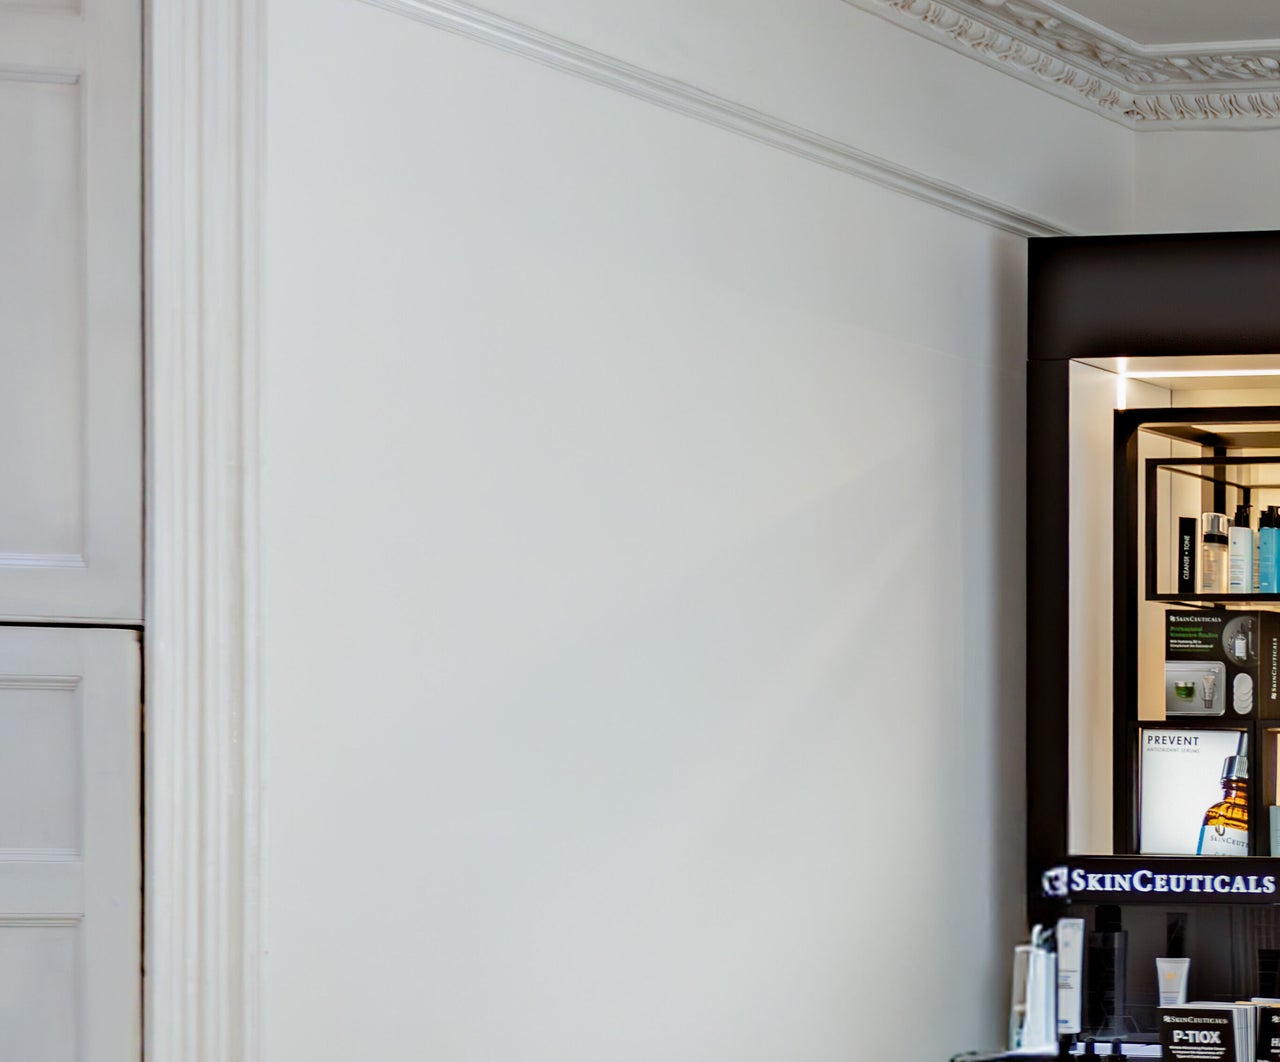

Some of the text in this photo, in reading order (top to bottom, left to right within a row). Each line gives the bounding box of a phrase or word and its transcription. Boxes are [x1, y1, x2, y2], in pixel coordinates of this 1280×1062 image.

[1148, 736, 1199, 746] PREVENT
[1070, 868, 1276, 894] SKINCEUTICALS
[1173, 1030, 1222, 1044] P-TIOX
